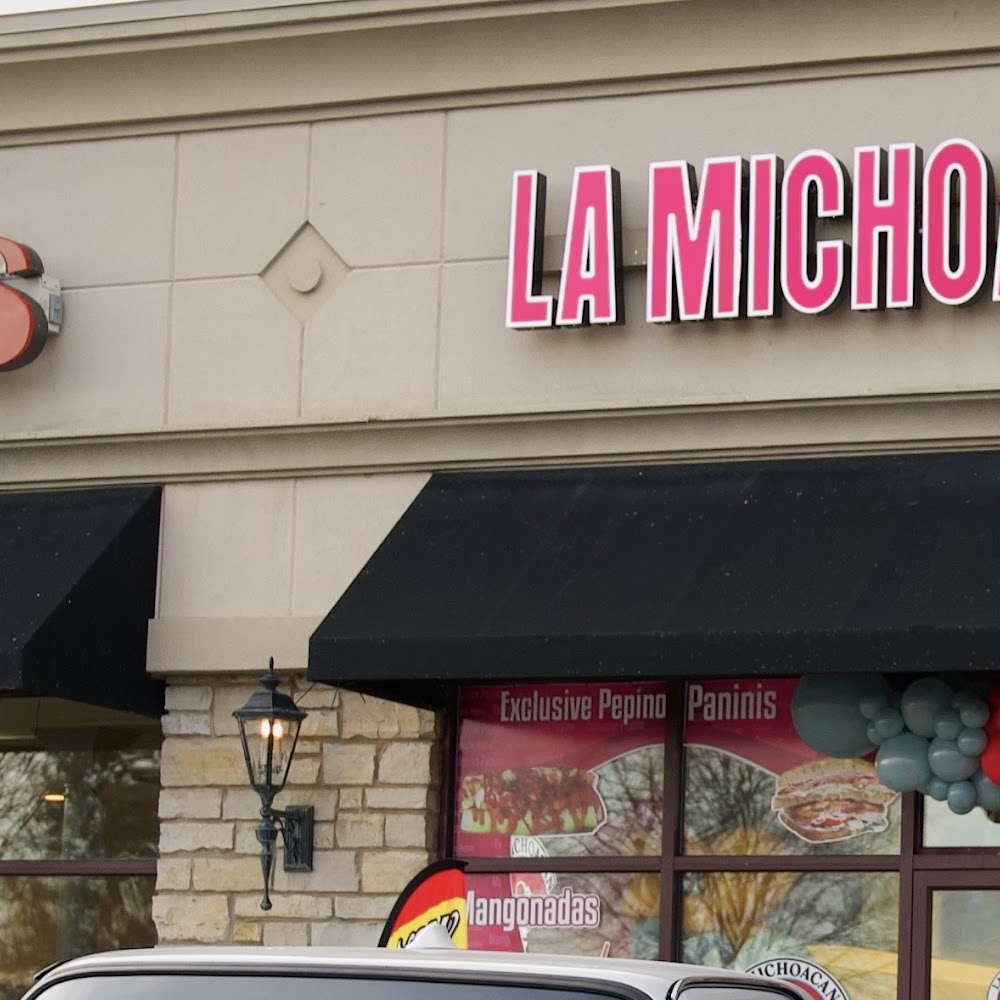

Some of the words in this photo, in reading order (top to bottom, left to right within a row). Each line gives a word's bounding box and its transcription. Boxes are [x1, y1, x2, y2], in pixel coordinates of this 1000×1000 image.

[506, 164, 618, 328] LA
[500, 689, 592, 722] Exclusive
[599, 687, 667, 726] Pepino
[687, 683, 777, 721] Paninis
